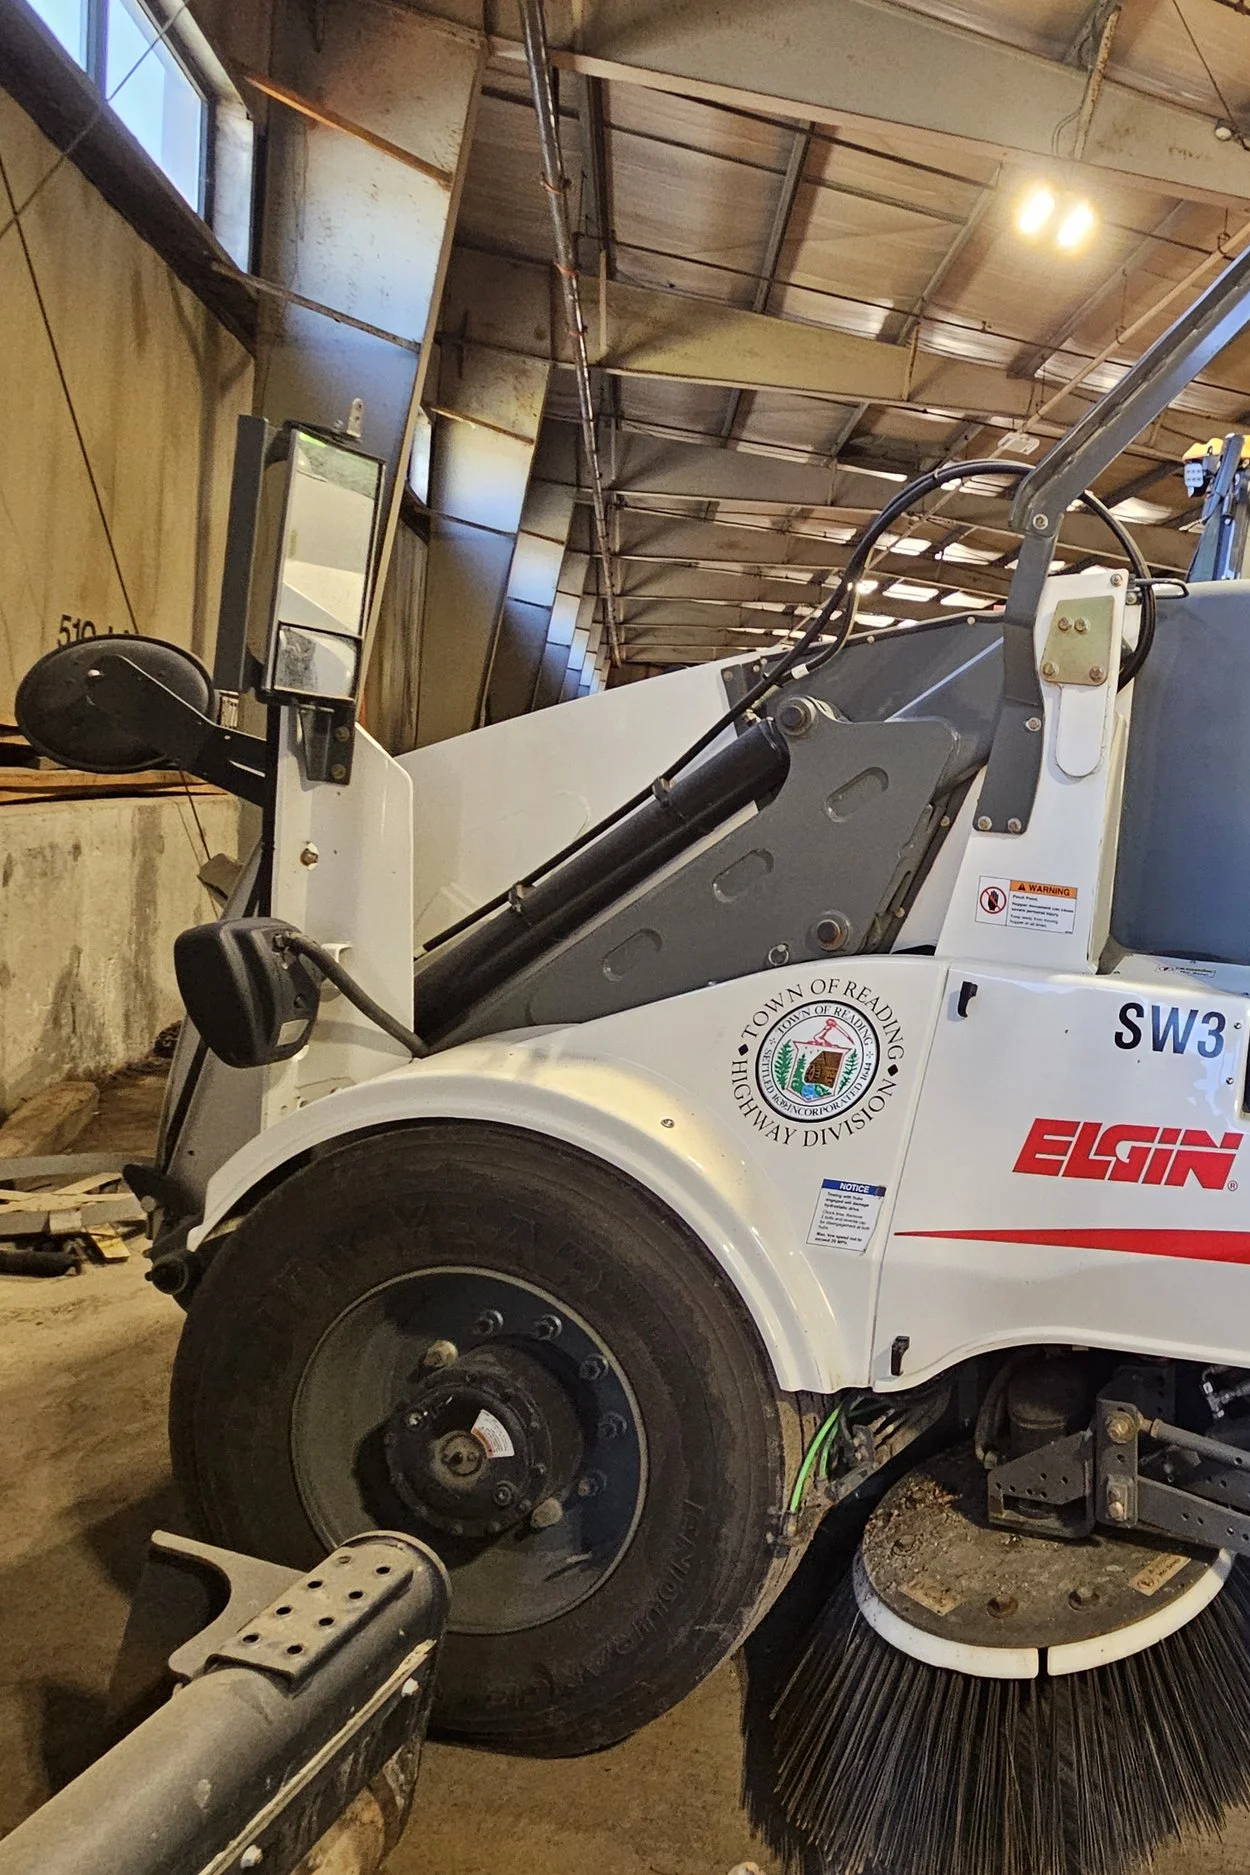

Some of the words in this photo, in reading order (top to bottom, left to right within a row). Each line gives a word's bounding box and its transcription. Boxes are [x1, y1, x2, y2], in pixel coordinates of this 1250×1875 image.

[1028, 884, 1070, 896] WARNING
[741, 984, 805, 1039] TOWN
[810, 978, 841, 995] OF
[843, 980, 905, 1061] READING
[776, 1007, 811, 1035] TOWN
[814, 1005, 832, 1015] OF
[833, 1006, 873, 1046] READING
[1114, 1002, 1226, 1058] SW3
[761, 1049, 775, 1094] SETTLED
[731, 1059, 797, 1146] HIGHWAY
[802, 1078, 897, 1147] DIVISION
[839, 1183, 870, 1193] NOTICE
